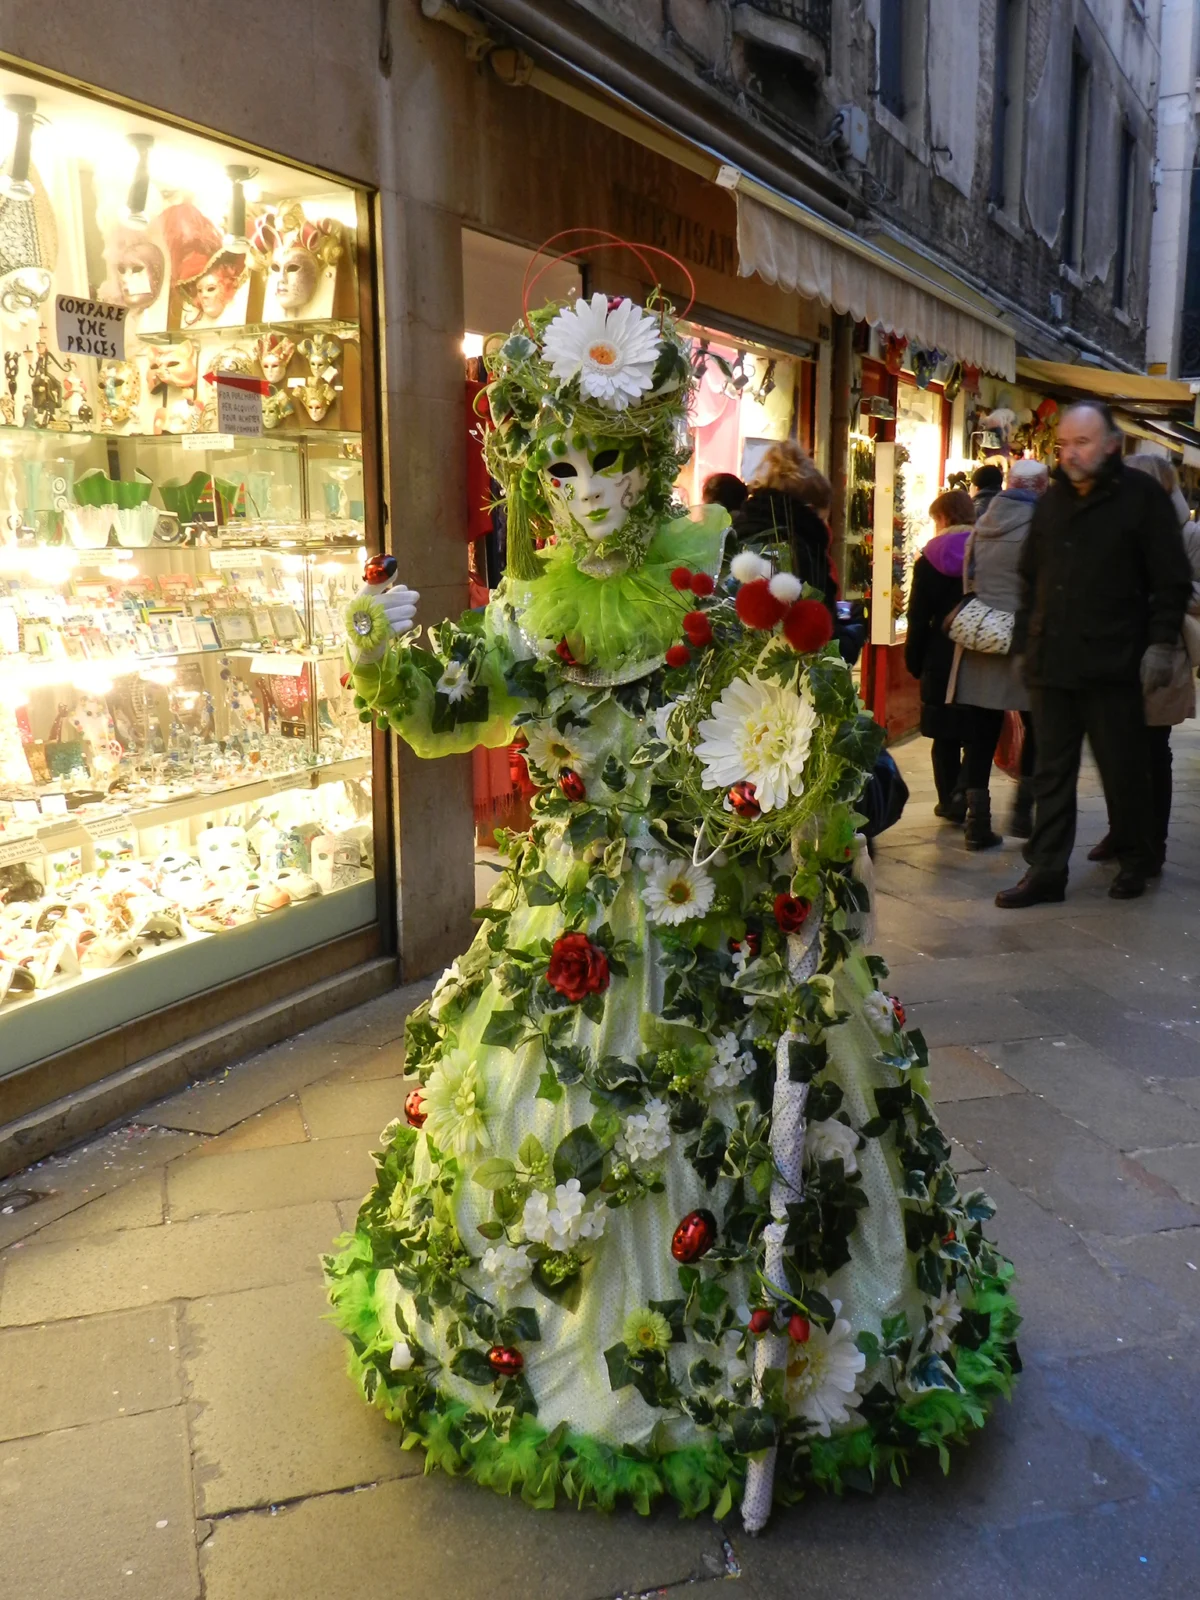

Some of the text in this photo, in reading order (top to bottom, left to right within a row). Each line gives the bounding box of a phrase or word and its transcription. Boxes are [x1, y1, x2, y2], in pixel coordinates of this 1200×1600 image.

[59, 298, 124, 321] COMPARE
[77, 317, 107, 338] THE
[67, 335, 116, 357] PRICES
